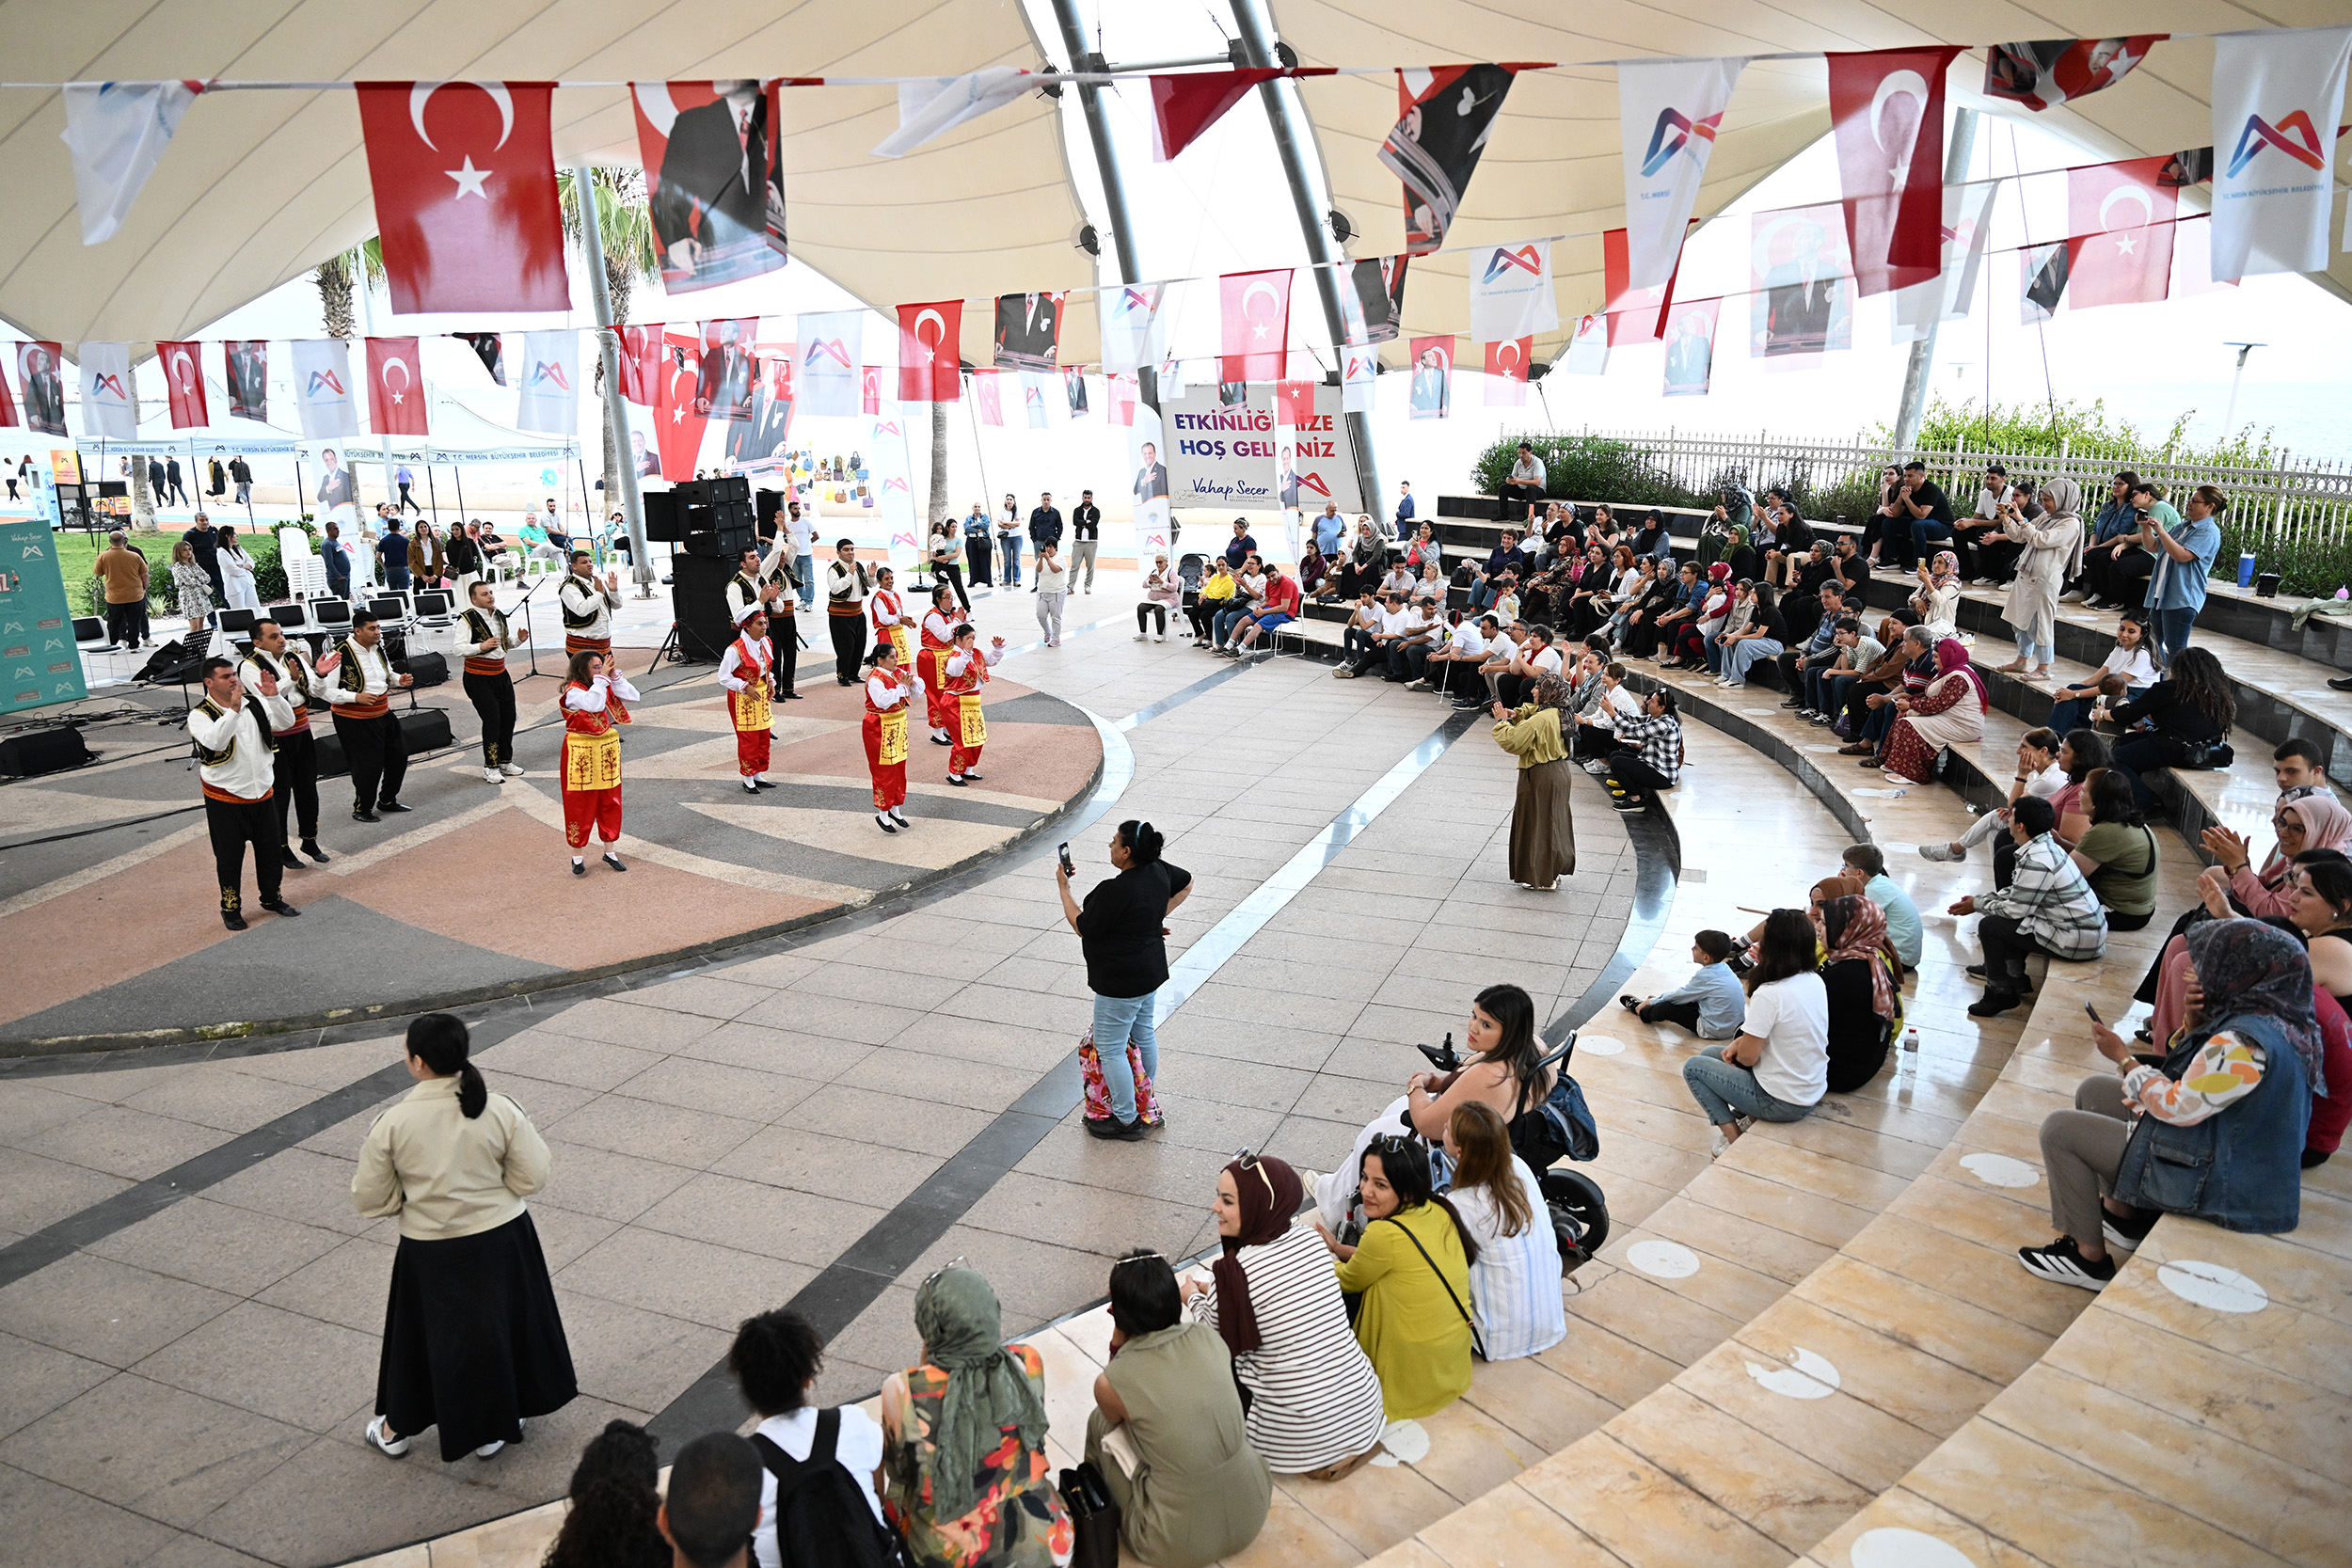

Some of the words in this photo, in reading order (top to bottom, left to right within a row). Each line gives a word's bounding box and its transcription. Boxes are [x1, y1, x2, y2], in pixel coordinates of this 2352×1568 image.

[1174, 409, 1334, 432] ETKİNLİĞİZE
[466, 452, 488, 461] MERSİN
[490, 451, 527, 460] BÜYÜKŞEHİR
[529, 449, 559, 458] BELEDİYESİ
[1180, 439, 1227, 460] HOŞ
[1233, 436, 1336, 458] GELNİZ
[1192, 477, 1233, 500] Vahap
[1236, 480, 1269, 496] Seçer
